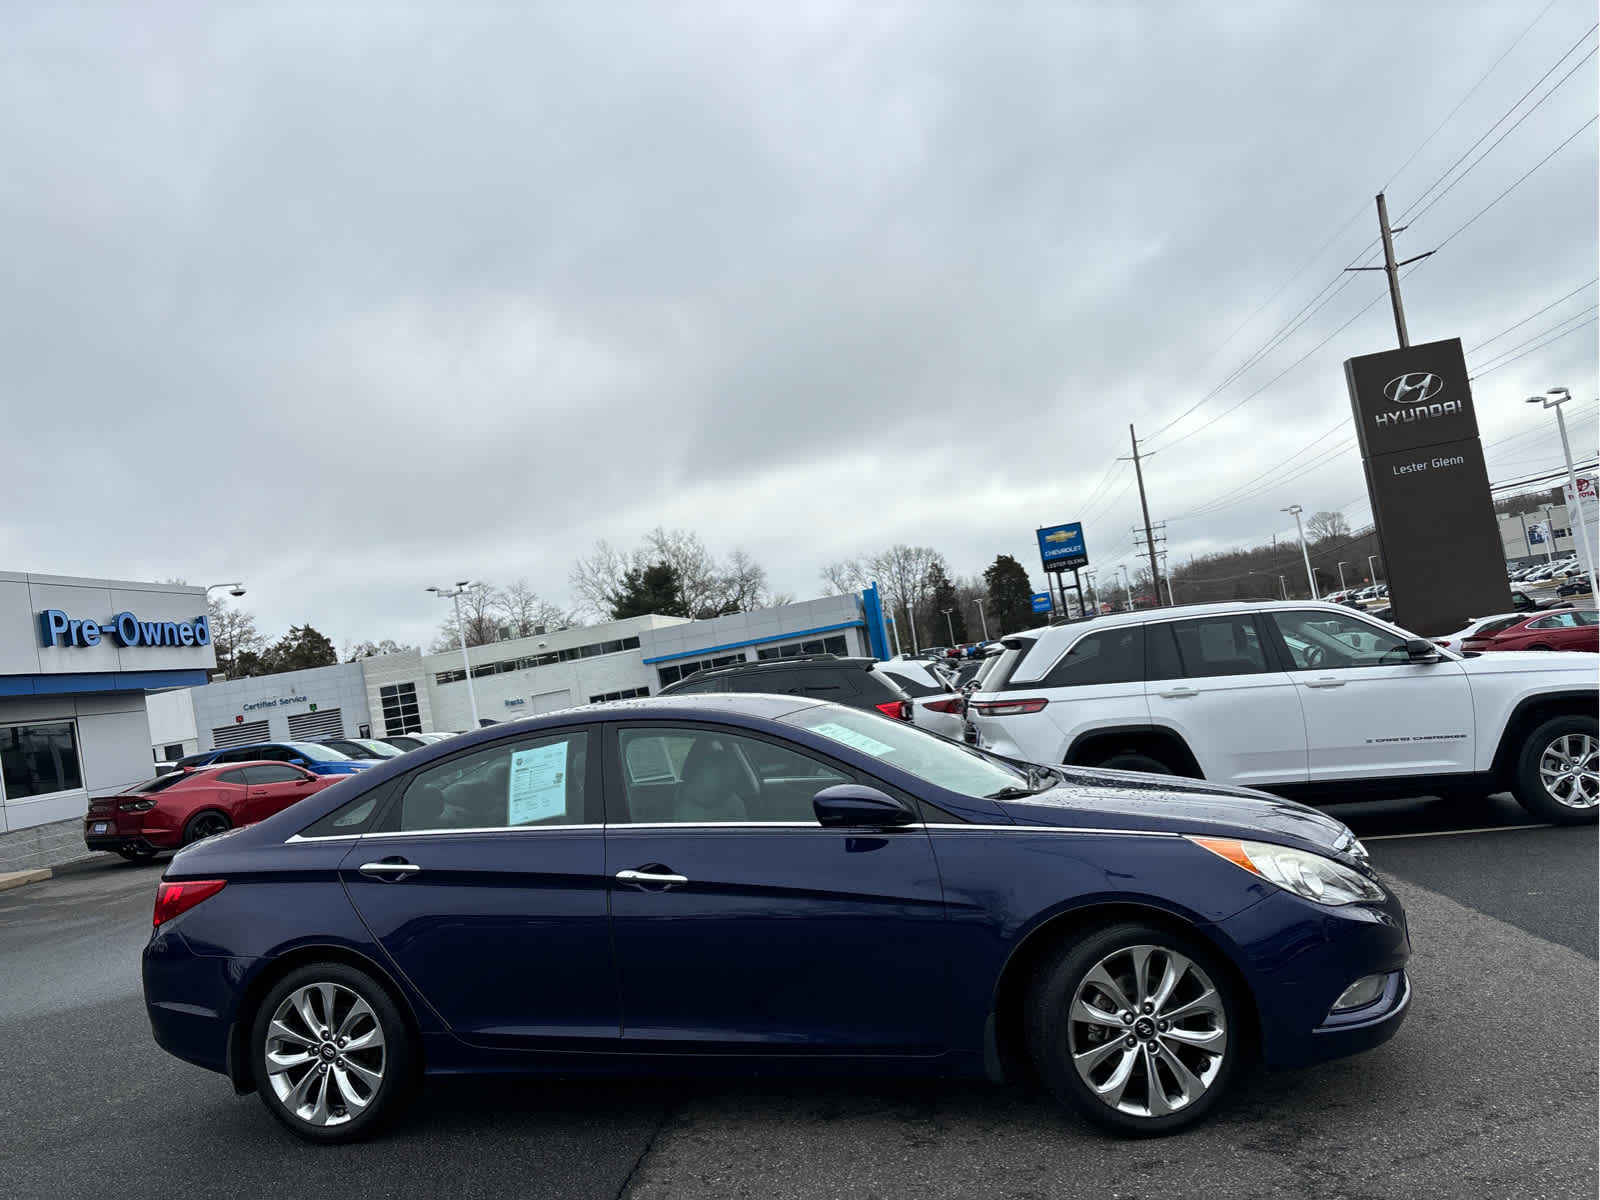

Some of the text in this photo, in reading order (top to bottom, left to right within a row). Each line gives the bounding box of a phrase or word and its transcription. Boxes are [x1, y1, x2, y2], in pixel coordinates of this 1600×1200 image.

[1375, 400, 1462, 427] HYUNDAI
[1392, 456, 1464, 475] Lester Glenn
[1568, 490, 1595, 500] TOTA
[1045, 545, 1081, 557] CHEVROLET
[41, 609, 210, 647] Pre-Owned
[243, 696, 307, 711] Certified Service
